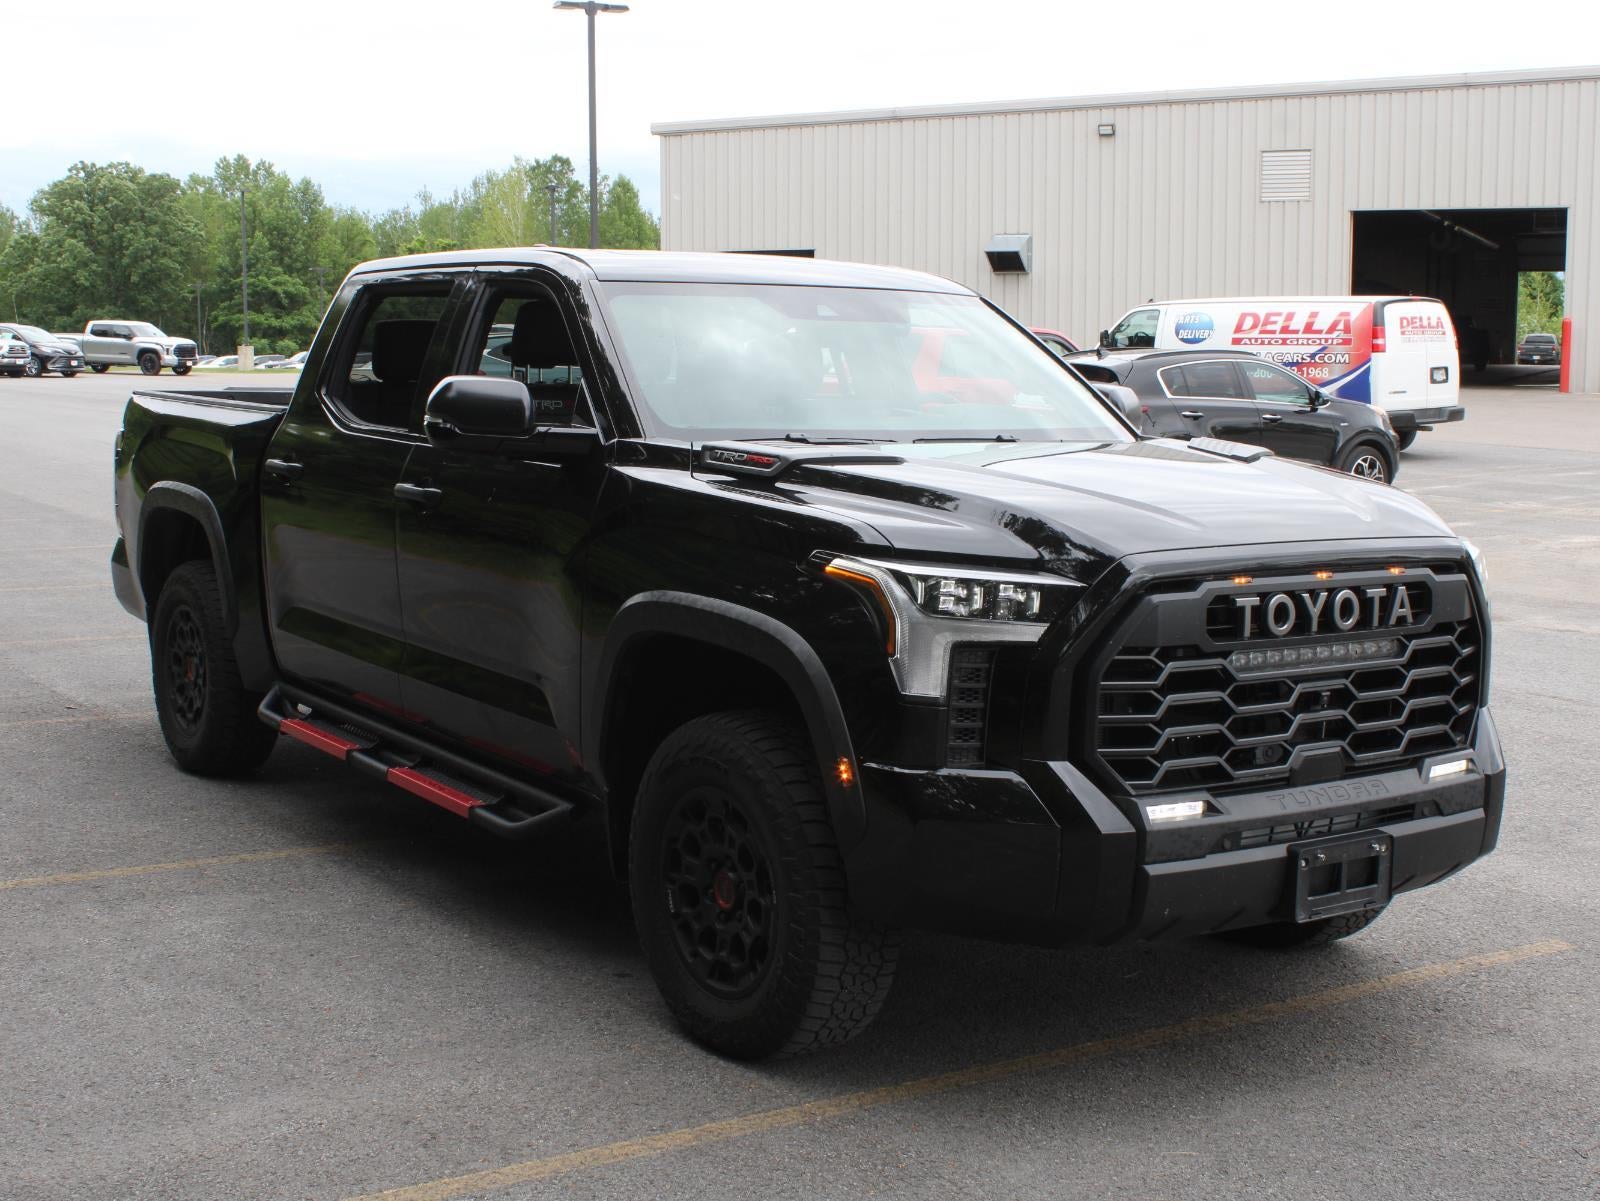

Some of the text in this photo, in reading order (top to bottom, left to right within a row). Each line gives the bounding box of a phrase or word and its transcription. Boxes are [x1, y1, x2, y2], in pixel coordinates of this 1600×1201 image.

[1233, 311, 1353, 335] DELLA
[1399, 315, 1445, 330] DELLA
[1178, 329, 1214, 339] DELIVERY
[714, 449, 748, 464] TRD
[1235, 586, 1414, 639] TOYOTA
[1265, 779, 1391, 811] TUNDRA
